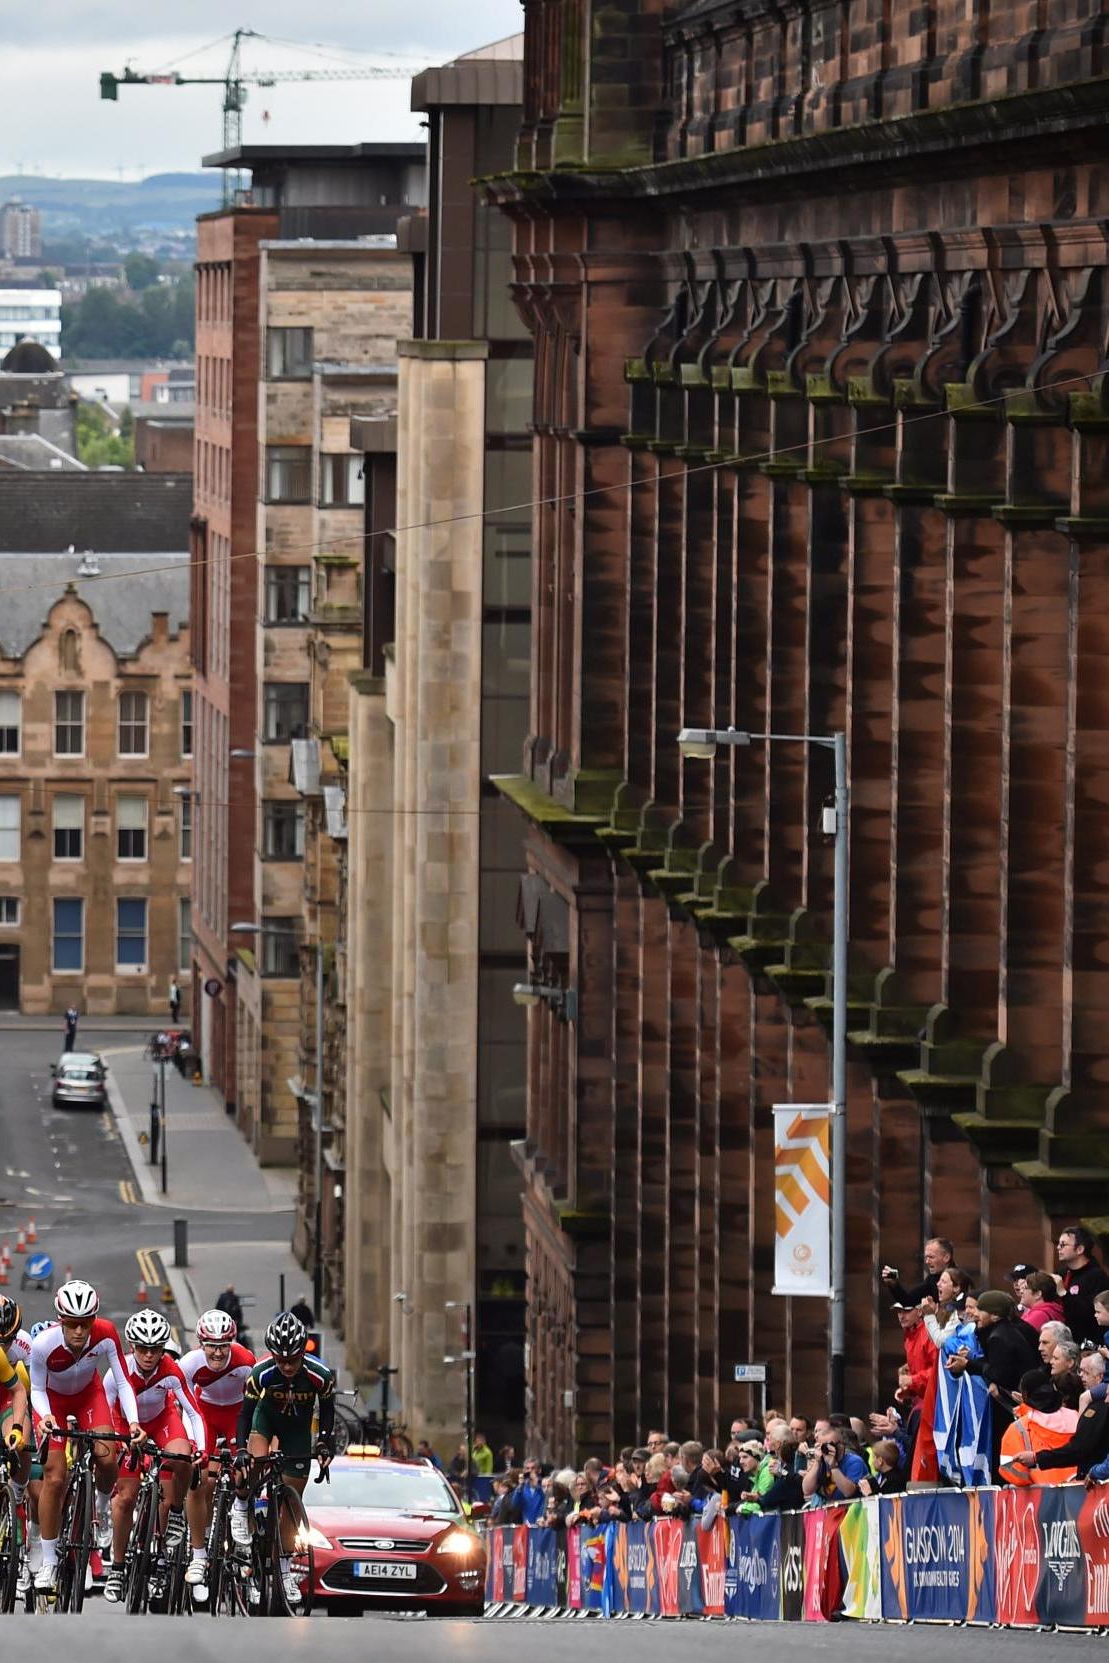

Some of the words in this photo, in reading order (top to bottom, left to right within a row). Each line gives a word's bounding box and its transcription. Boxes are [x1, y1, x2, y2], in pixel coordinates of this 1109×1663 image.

[905, 1525, 947, 1565] GLASGOW
[948, 1525, 965, 1564] 2014
[364, 1562, 389, 1577] AE14
[391, 1562, 412, 1577] ZYL
